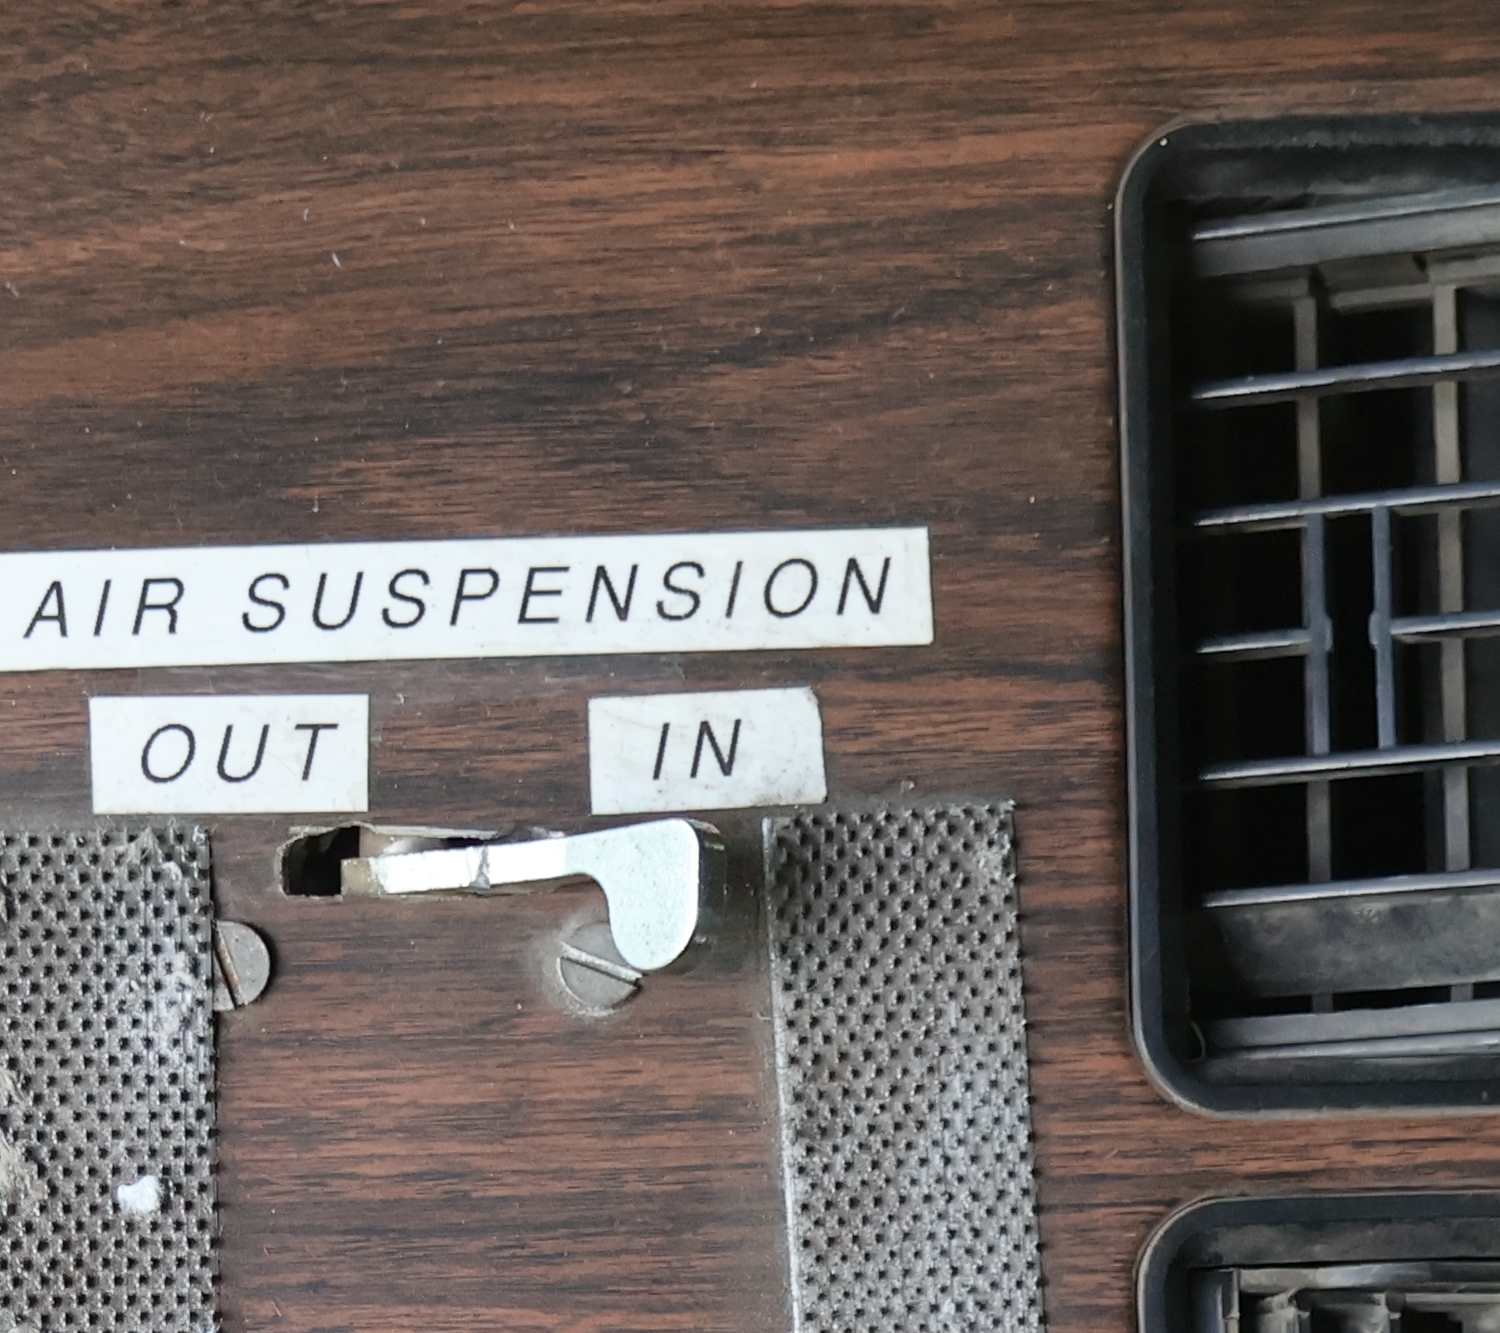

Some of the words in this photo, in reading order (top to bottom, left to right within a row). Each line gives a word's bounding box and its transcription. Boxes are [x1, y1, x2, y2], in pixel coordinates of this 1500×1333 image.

[23, 576, 187, 640] AIR
[241, 555, 894, 635] SUSPENSION
[139, 722, 339, 785] OUT
[651, 718, 743, 781] IN
